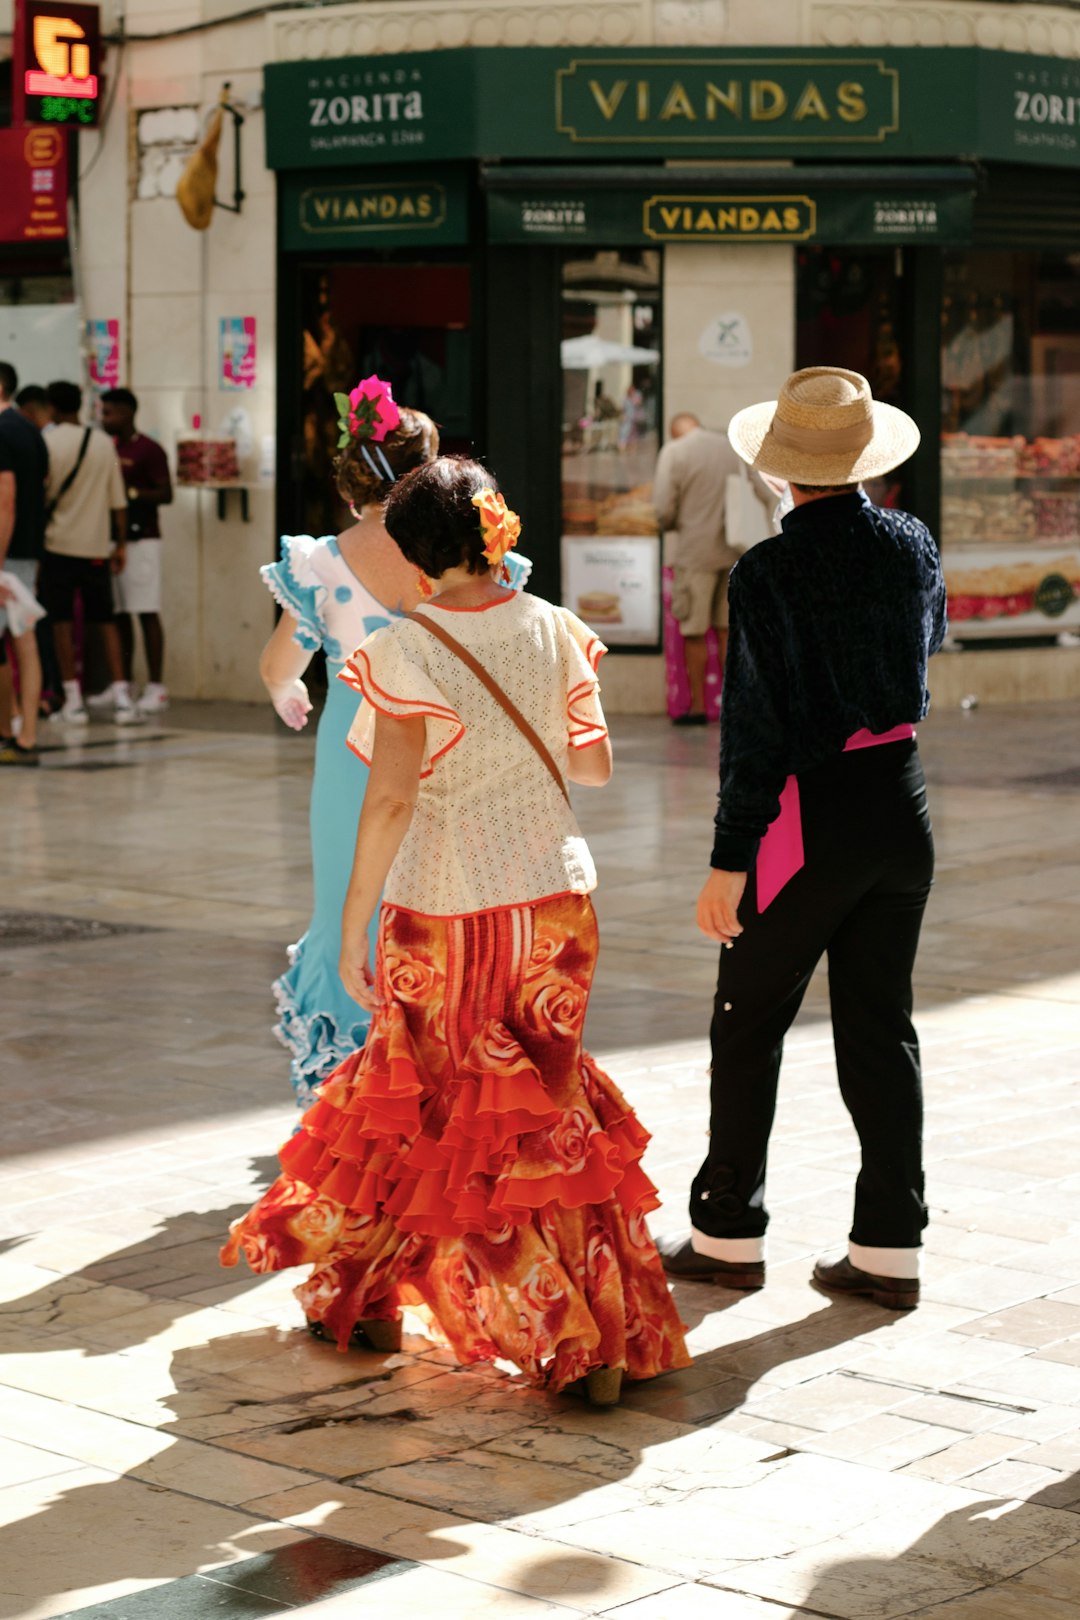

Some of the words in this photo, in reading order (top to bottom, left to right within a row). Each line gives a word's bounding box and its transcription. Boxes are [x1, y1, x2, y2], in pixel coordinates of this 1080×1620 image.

[588, 80, 868, 122] VIANDAS
[313, 194, 432, 220] VIANDAS
[659, 207, 801, 231] VIANDAS
